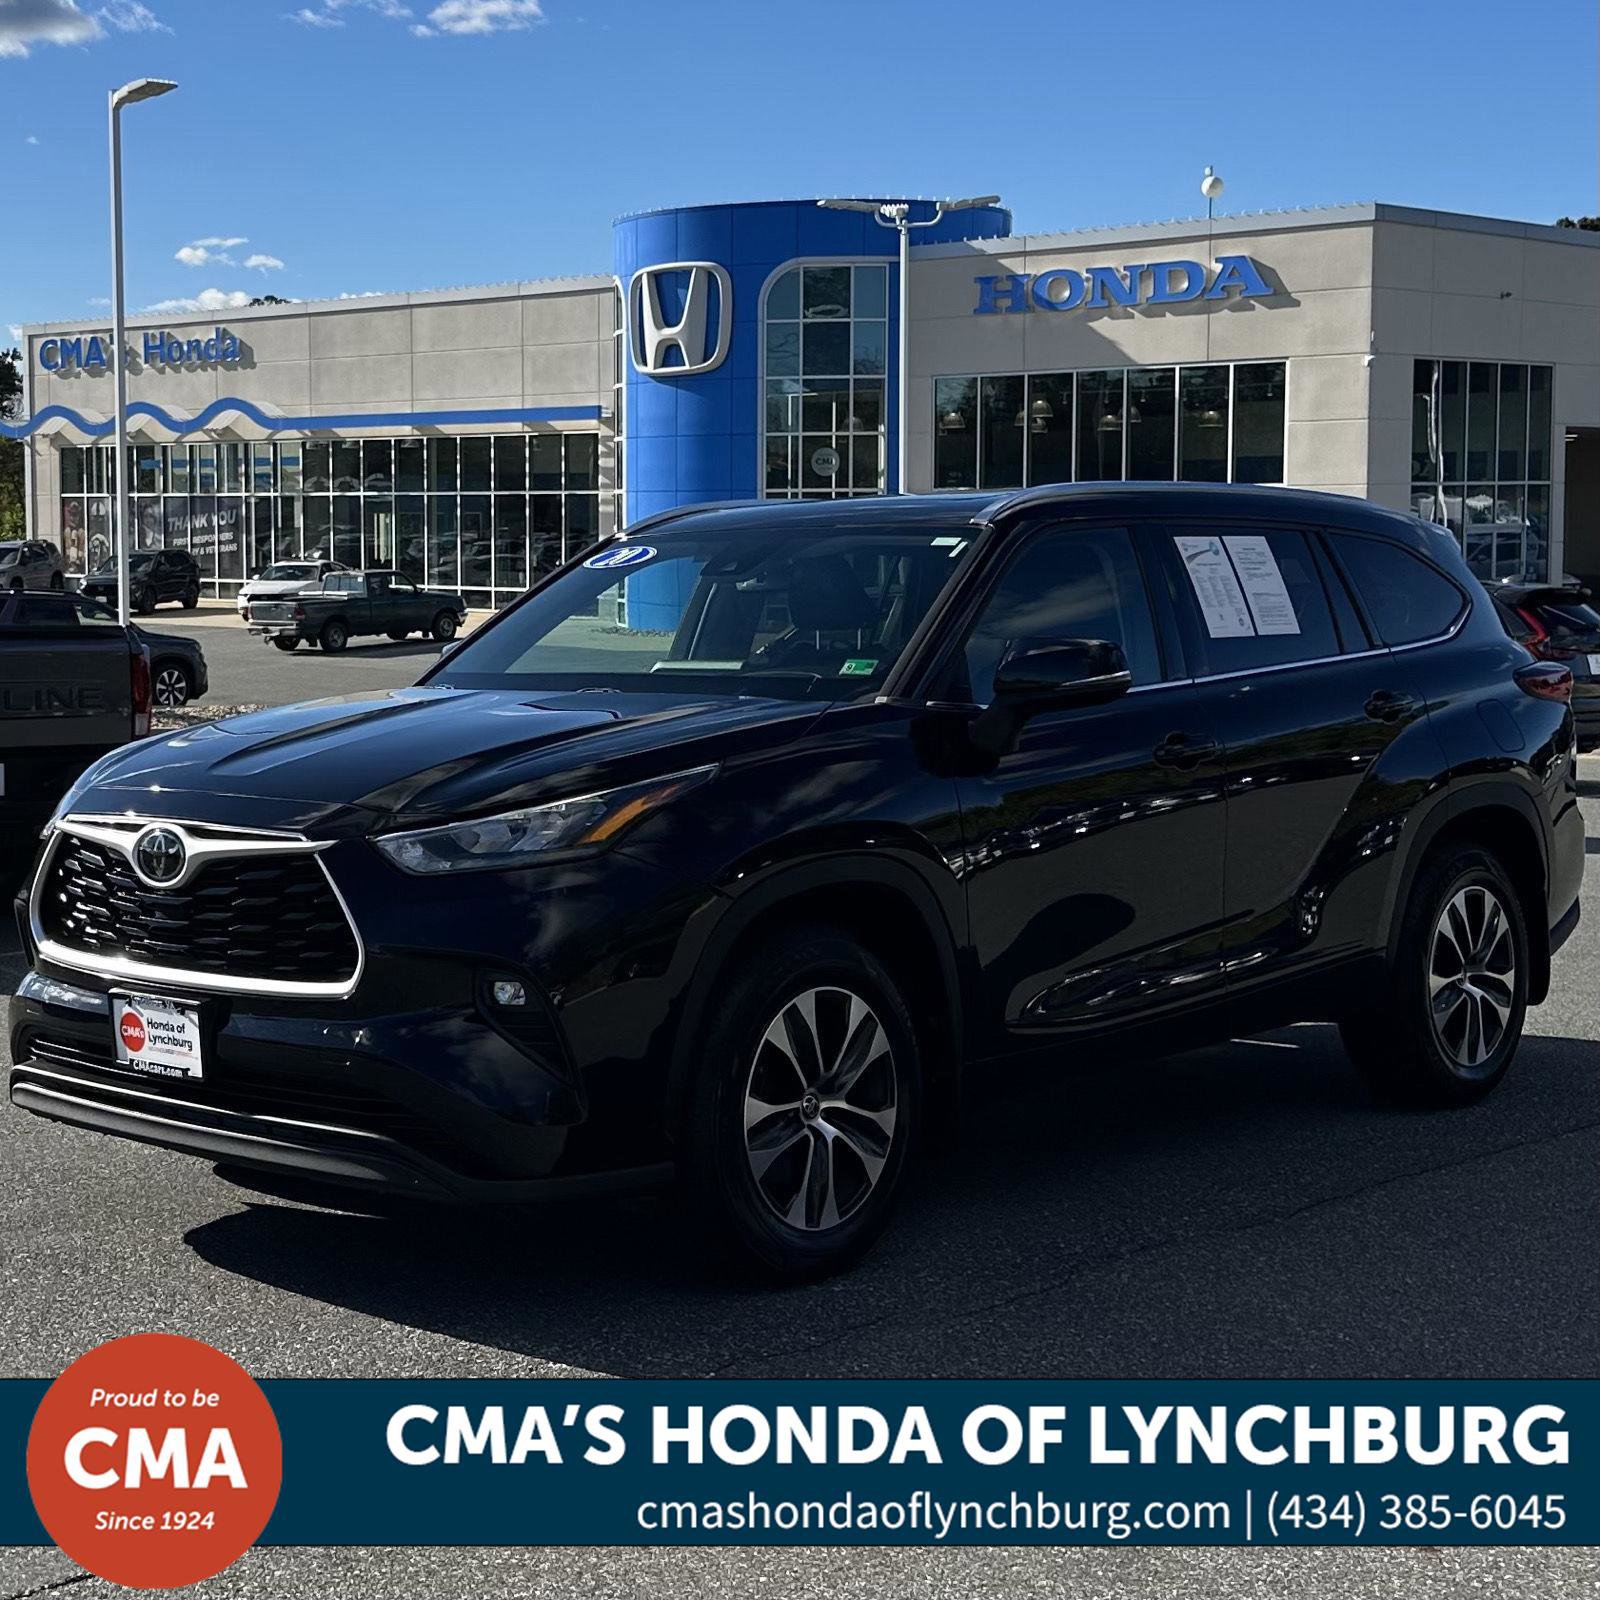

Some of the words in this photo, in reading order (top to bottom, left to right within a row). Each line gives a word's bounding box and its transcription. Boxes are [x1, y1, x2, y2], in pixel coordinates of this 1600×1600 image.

[973, 255, 1273, 314] HONDA
[142, 326, 241, 365] Honda
[168, 513, 208, 531] THANK
[212, 509, 237, 526] YOU
[206, 543, 238, 555] VETRANS
[147, 1017, 175, 1033] Honda
[176, 1023, 186, 1034] of
[148, 1031, 193, 1052] Lynchburg
